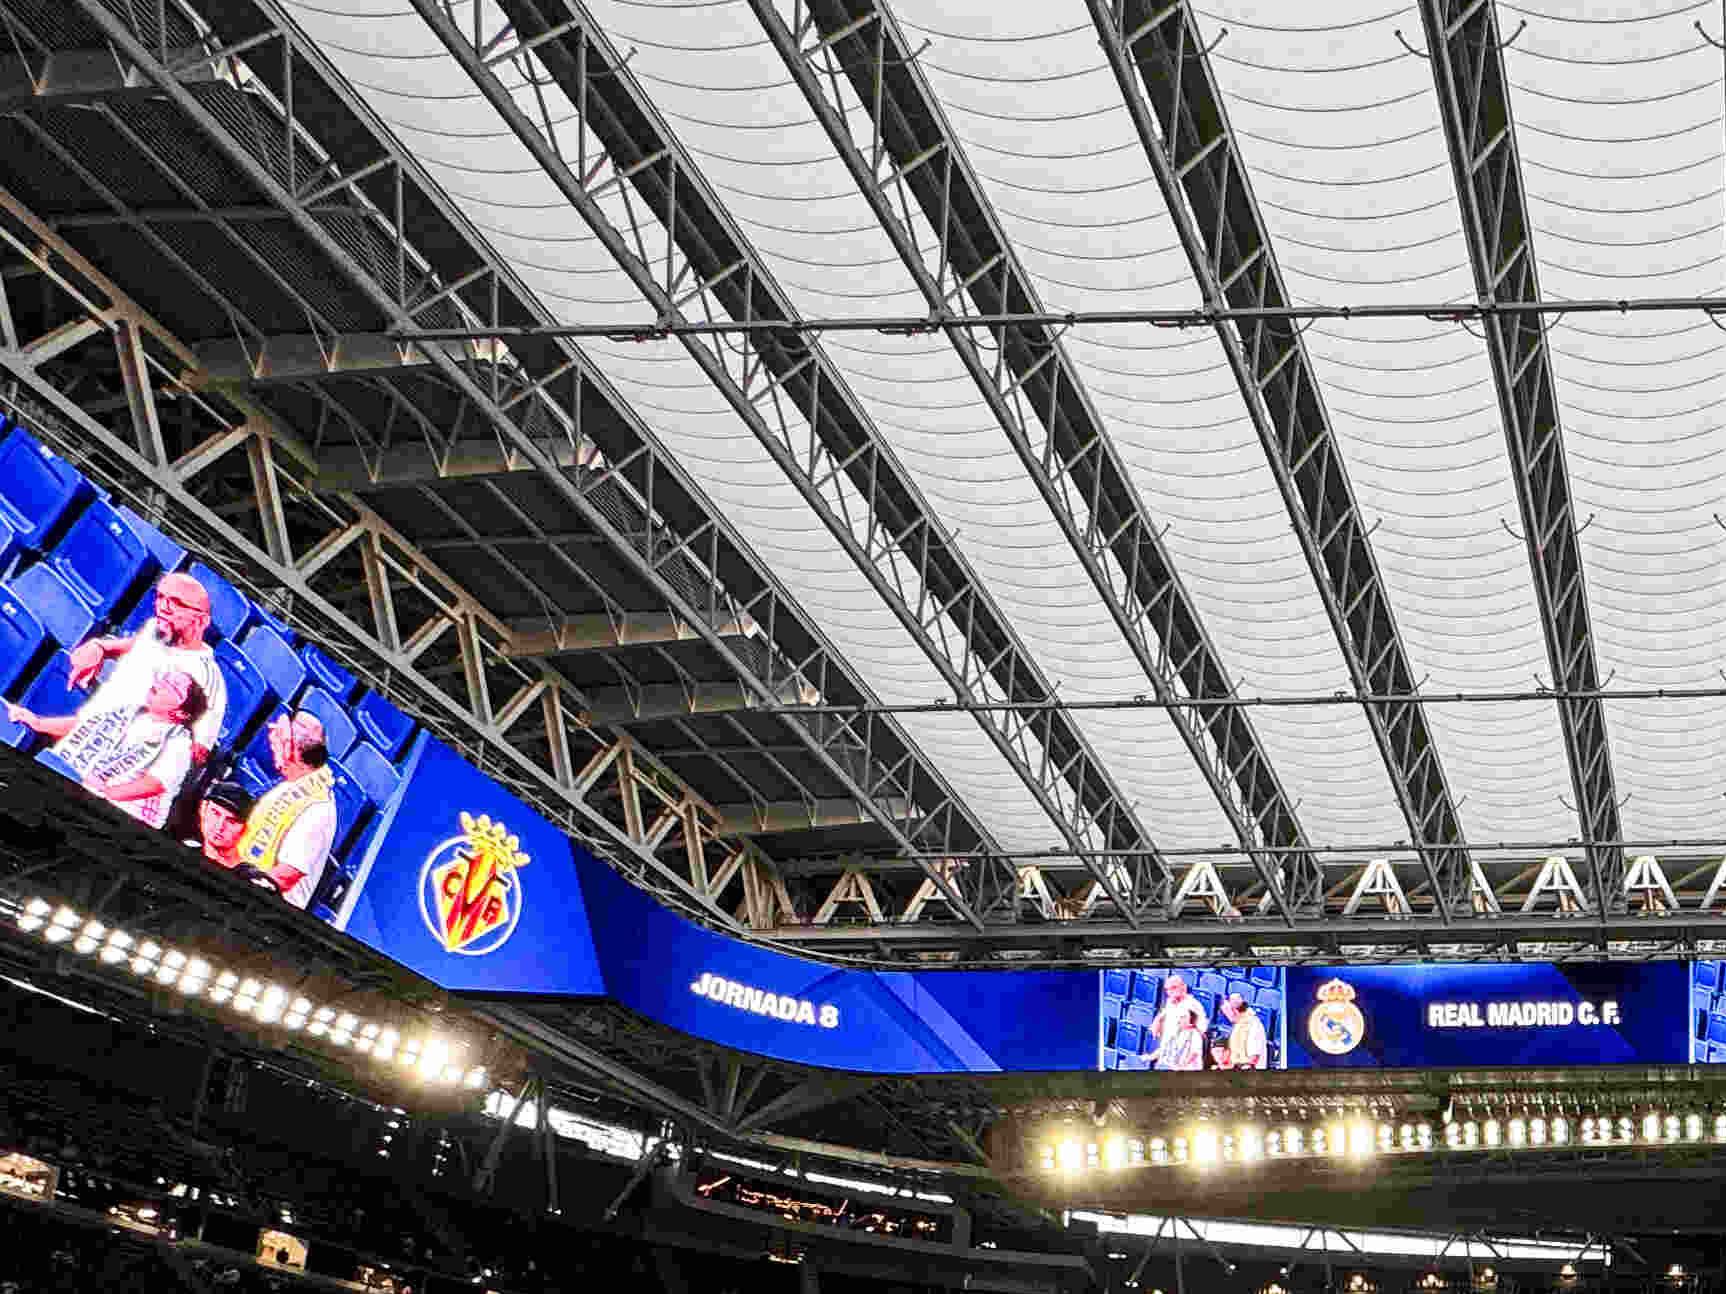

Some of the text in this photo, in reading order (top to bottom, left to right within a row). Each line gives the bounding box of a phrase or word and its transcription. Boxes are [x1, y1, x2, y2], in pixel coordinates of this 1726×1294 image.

[690, 972, 839, 1028] JORNADA 8
[1429, 1001, 1621, 1027] REAL MADRID C. F.
